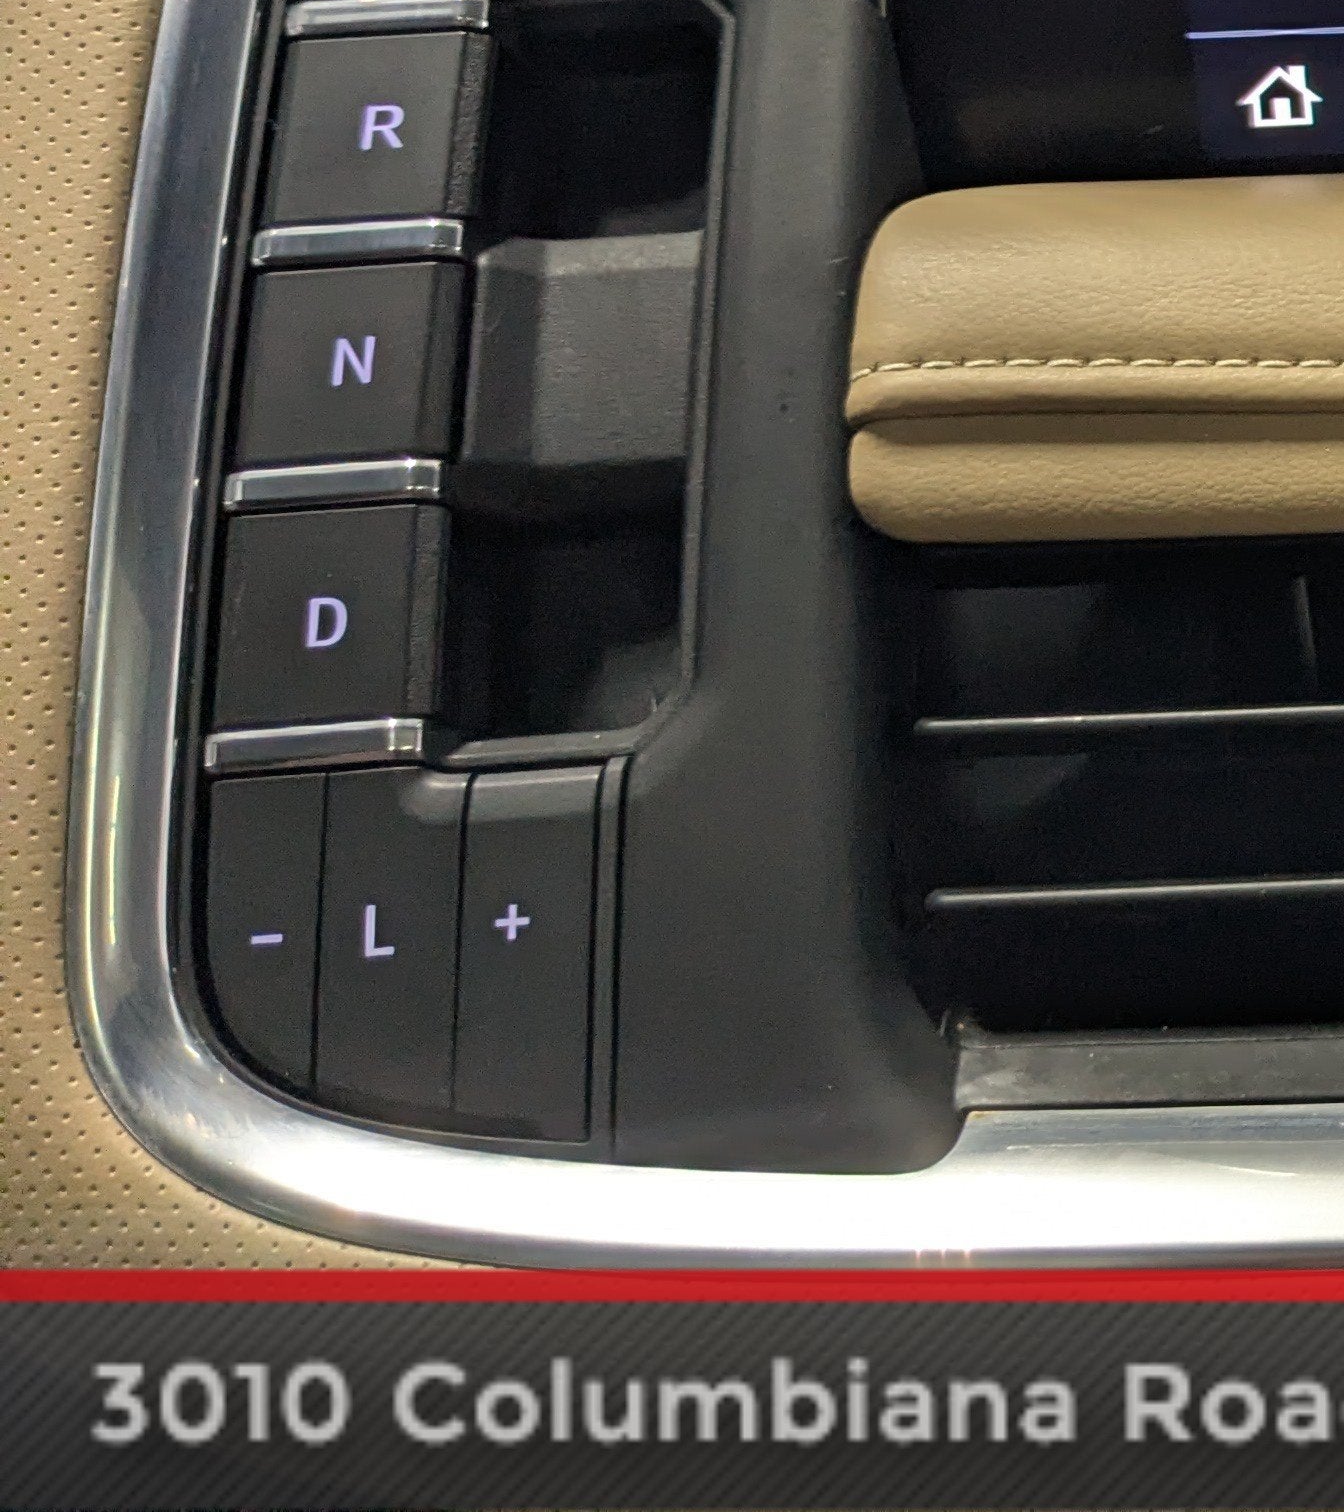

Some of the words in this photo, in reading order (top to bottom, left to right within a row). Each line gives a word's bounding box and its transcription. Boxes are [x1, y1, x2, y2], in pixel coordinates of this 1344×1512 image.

[359, 104, 404, 151] R
[331, 336, 375, 386] N
[306, 597, 347, 647] D
[365, 905, 394, 957] L
